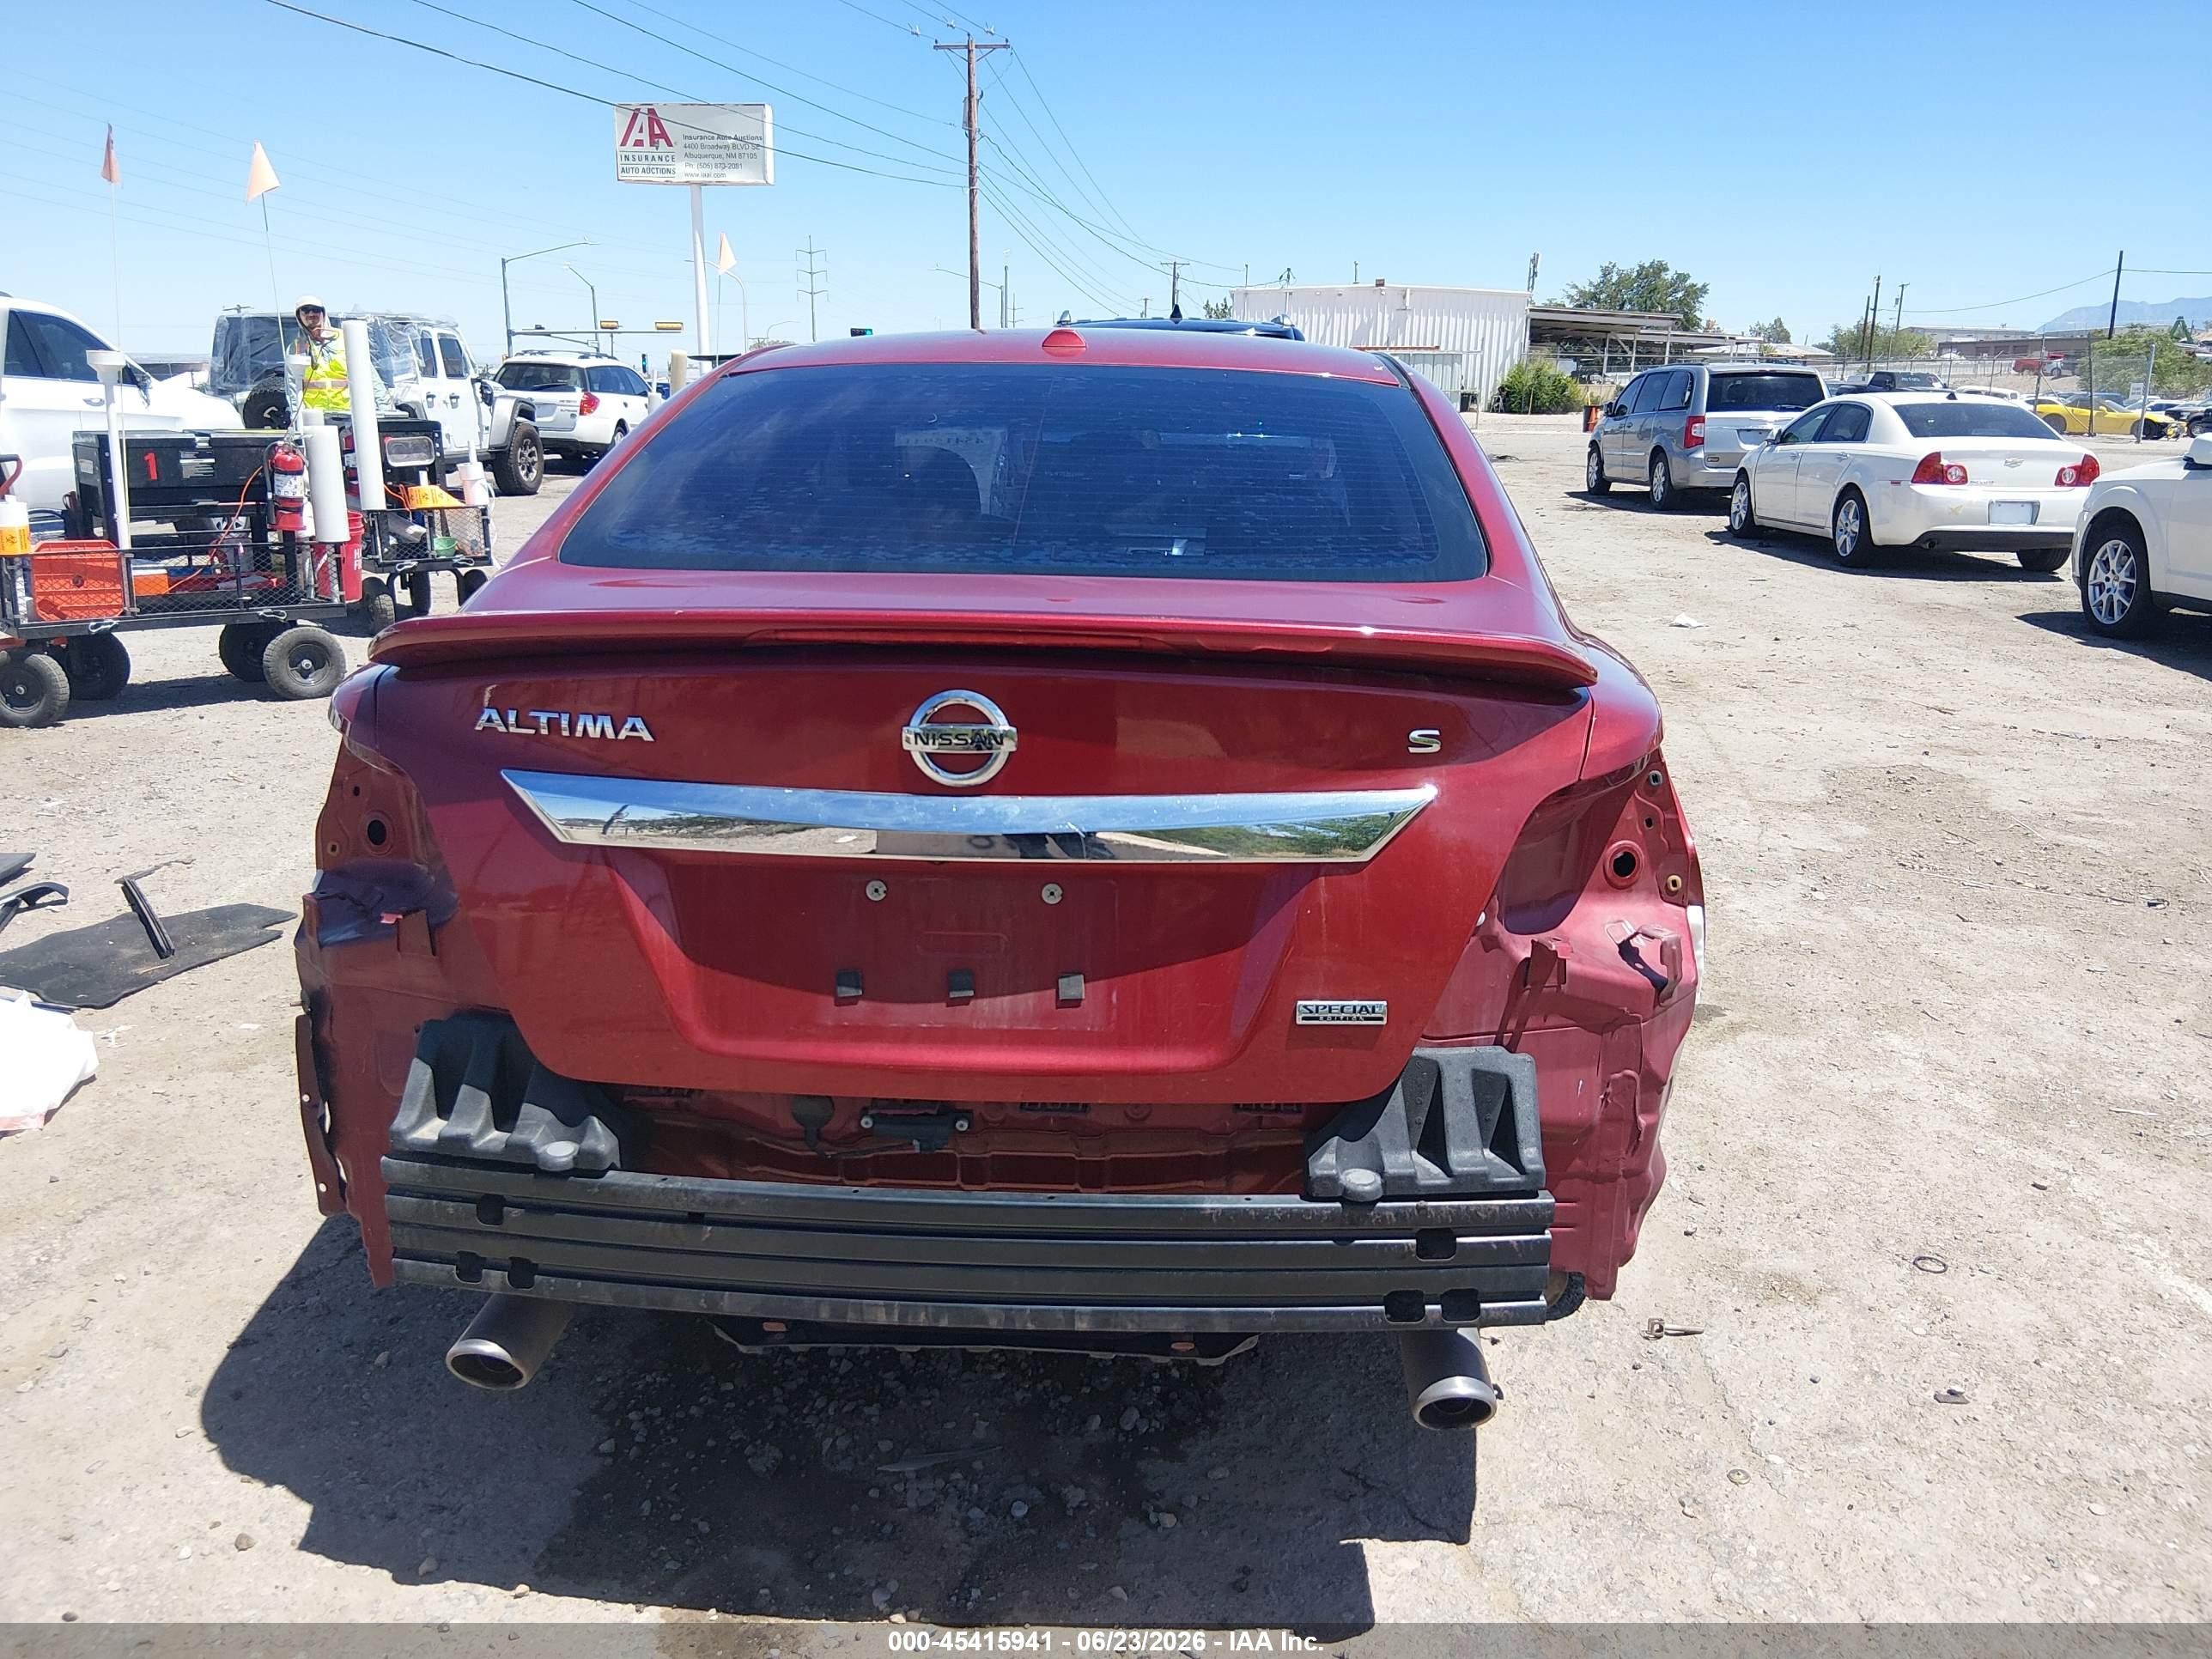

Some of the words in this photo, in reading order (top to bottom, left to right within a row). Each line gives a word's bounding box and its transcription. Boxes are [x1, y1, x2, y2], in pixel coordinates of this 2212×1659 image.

[641, 167, 676, 175] AUCTIONS
[144, 452, 158, 480] 1
[475, 708, 655, 742] ALTIMA
[915, 733, 1004, 745] NISSAN
[1408, 730, 1441, 753] S
[1302, 1005, 1384, 1014] SPECIAL
